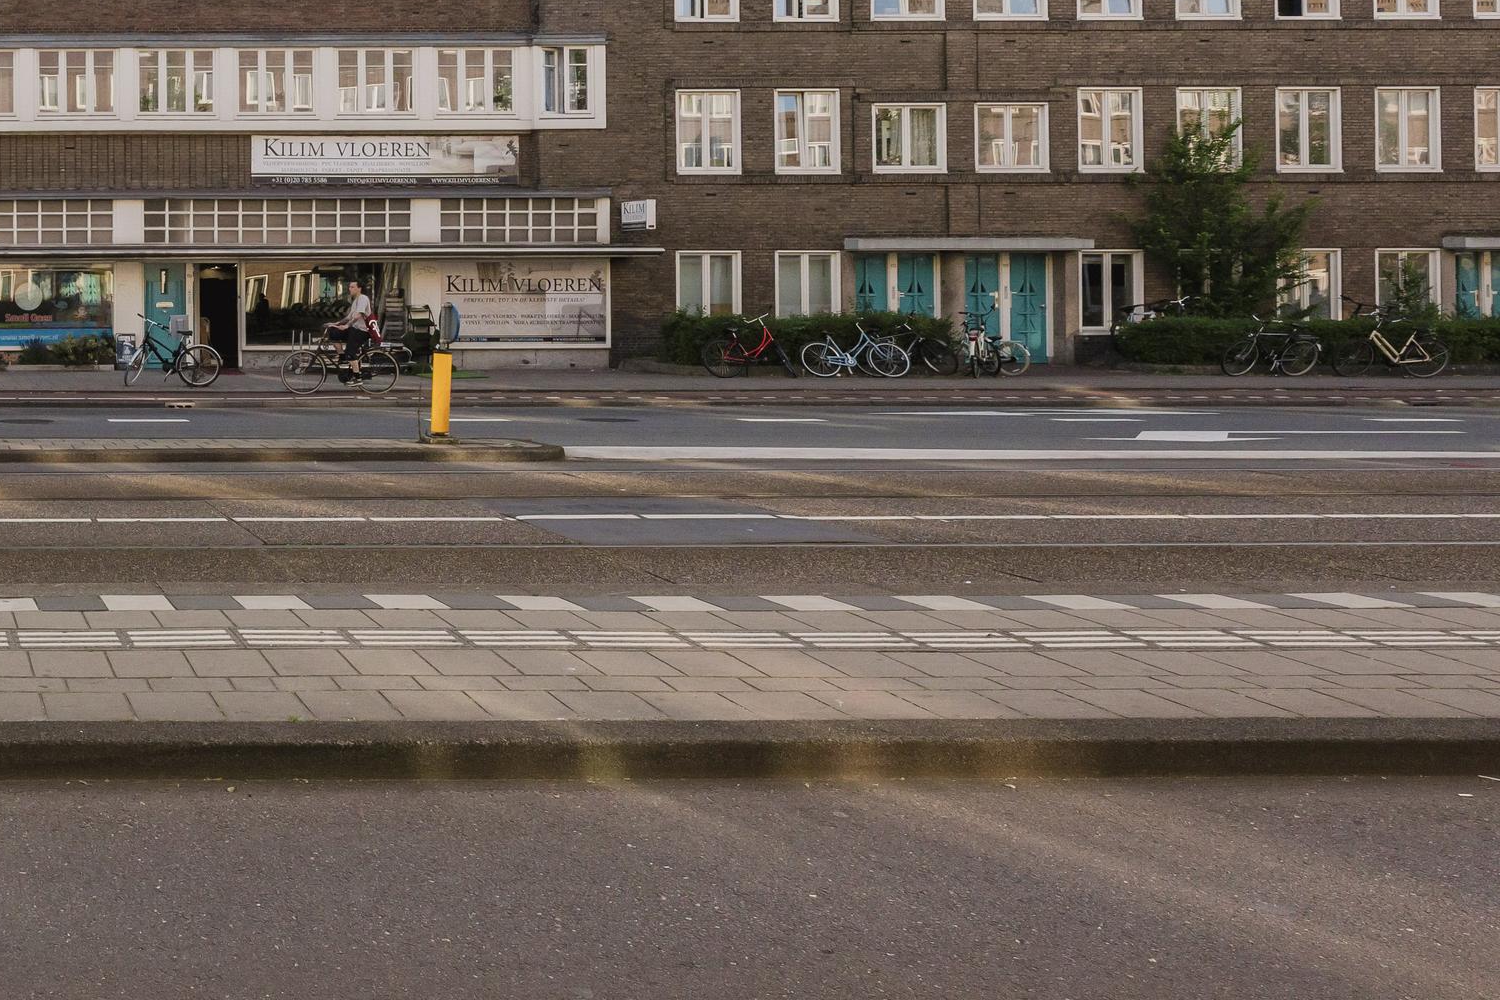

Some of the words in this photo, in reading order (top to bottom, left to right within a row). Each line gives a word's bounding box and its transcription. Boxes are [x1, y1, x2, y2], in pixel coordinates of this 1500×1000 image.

[263, 138, 325, 157] KILIM
[335, 142, 431, 157] VLOEREN
[623, 202, 645, 215] KILIM
[446, 275, 502, 293] KILIM
[513, 277, 602, 293] VLOEREN
